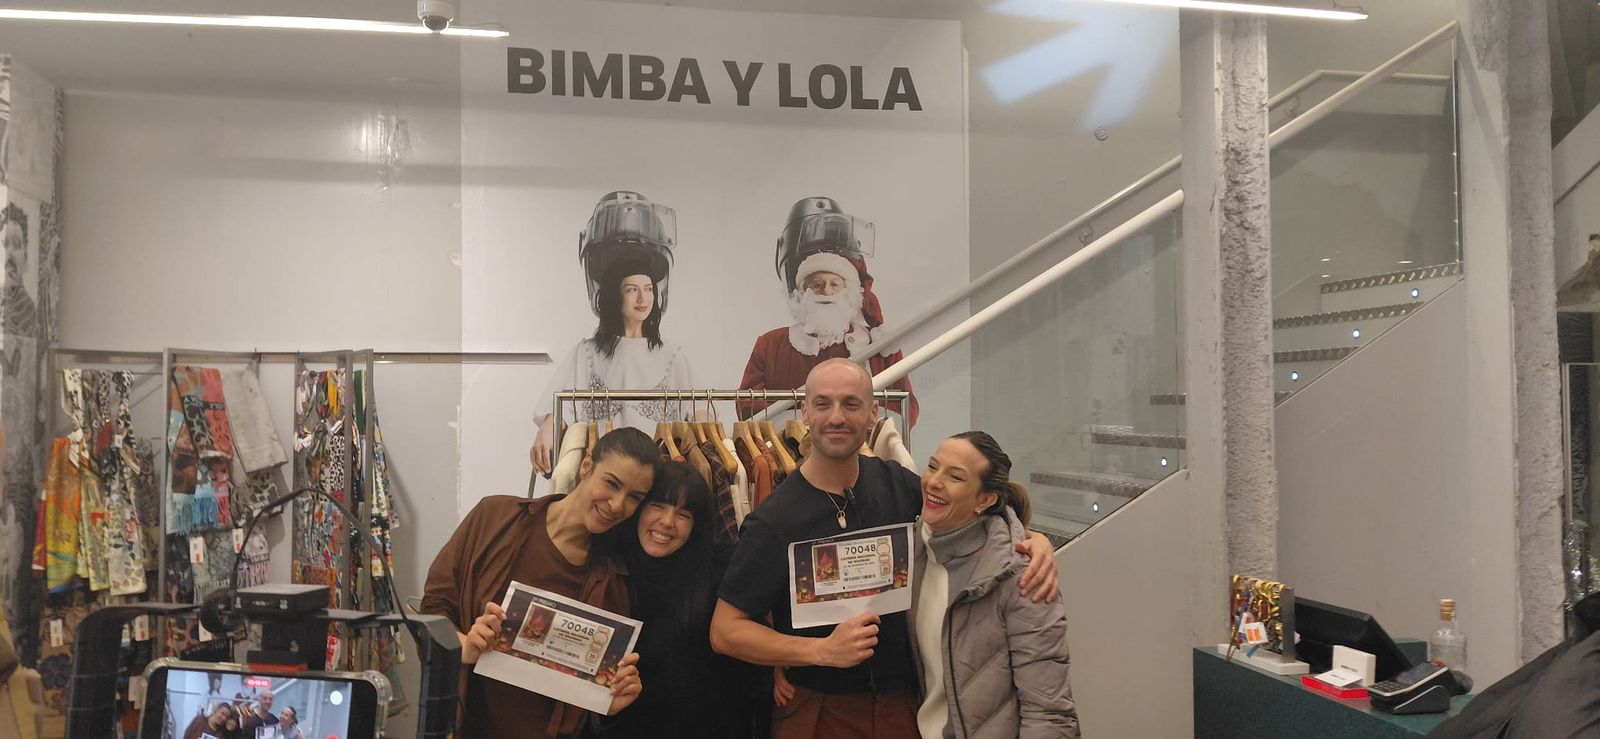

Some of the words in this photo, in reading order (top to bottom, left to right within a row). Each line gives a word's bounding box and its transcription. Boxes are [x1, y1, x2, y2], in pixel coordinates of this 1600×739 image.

[507, 46, 711, 104] BIMBA
[722, 60, 764, 106] Y
[778, 62, 923, 111] LOLA
[844, 544, 876, 555] 70048
[561, 619, 595, 637] 70048
